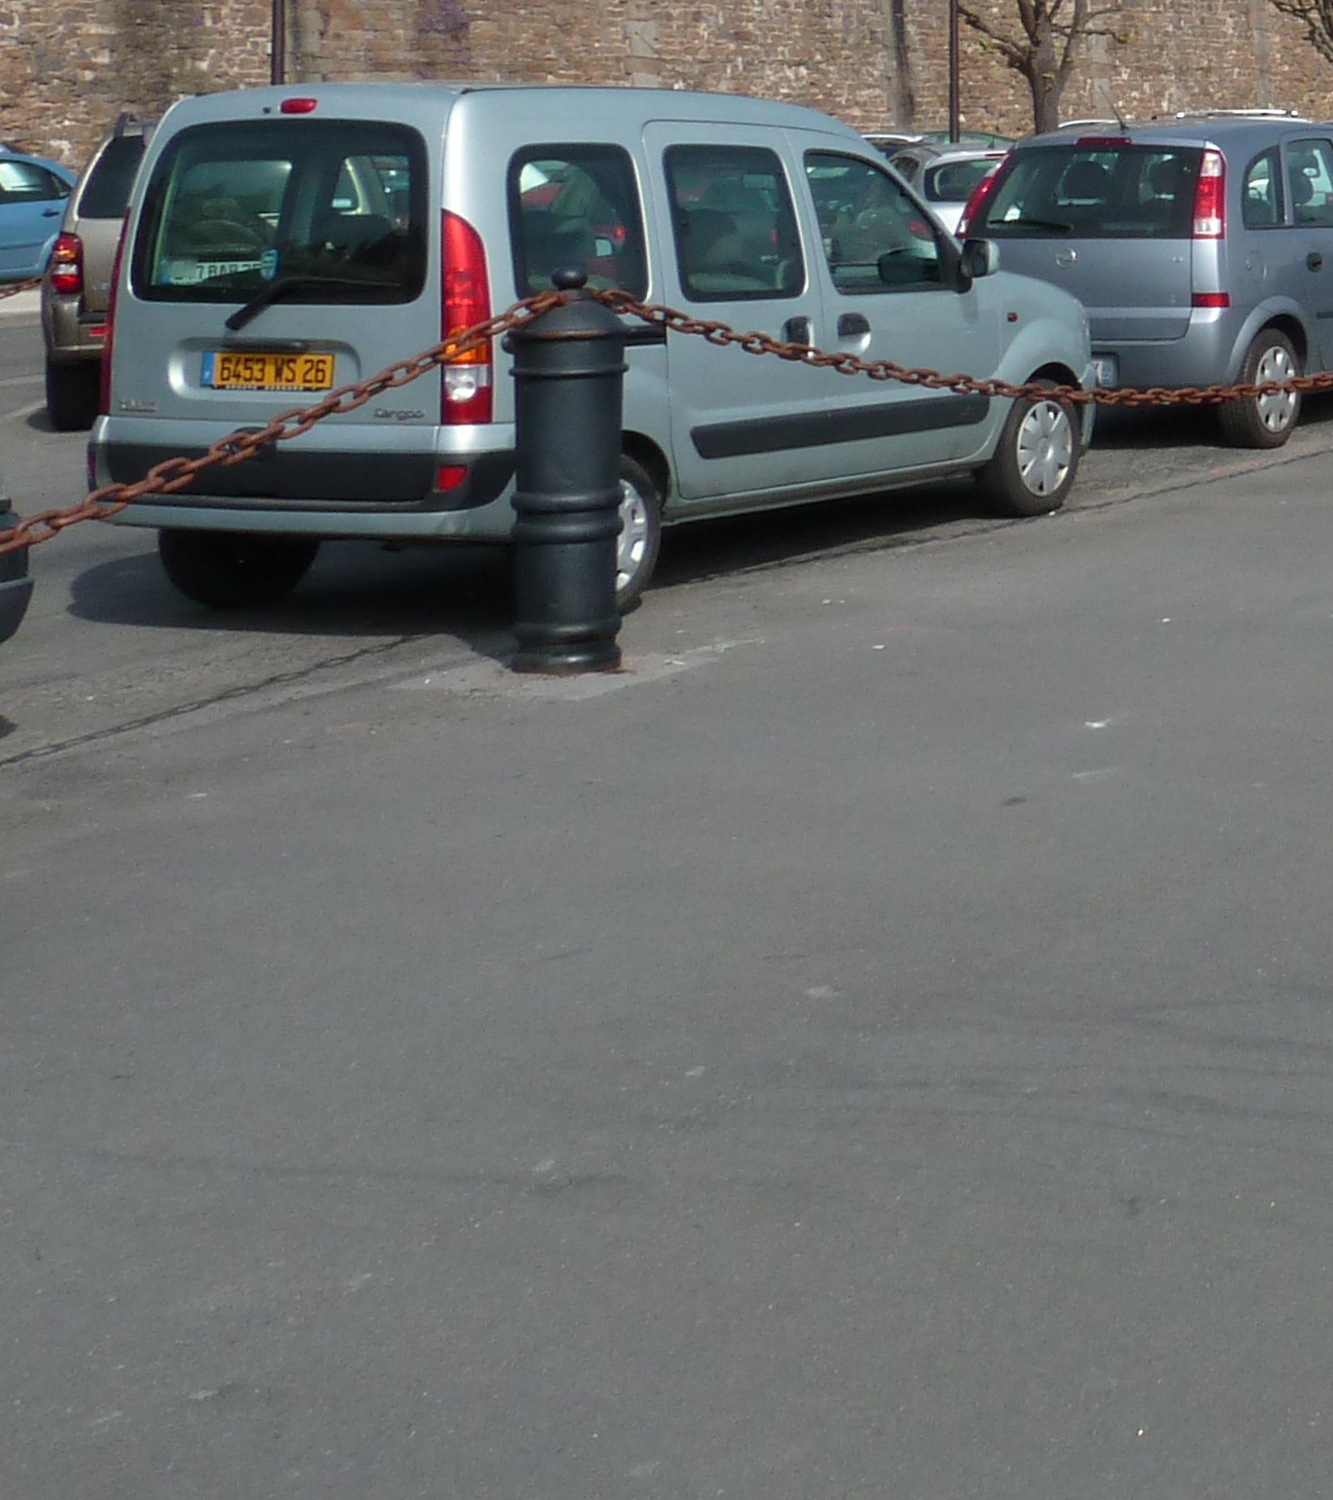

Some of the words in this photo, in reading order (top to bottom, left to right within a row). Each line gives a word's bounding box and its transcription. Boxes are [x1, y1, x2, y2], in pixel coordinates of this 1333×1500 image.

[220, 358, 266, 382] 6453
[274, 358, 297, 383] WS
[302, 359, 327, 384] 26
